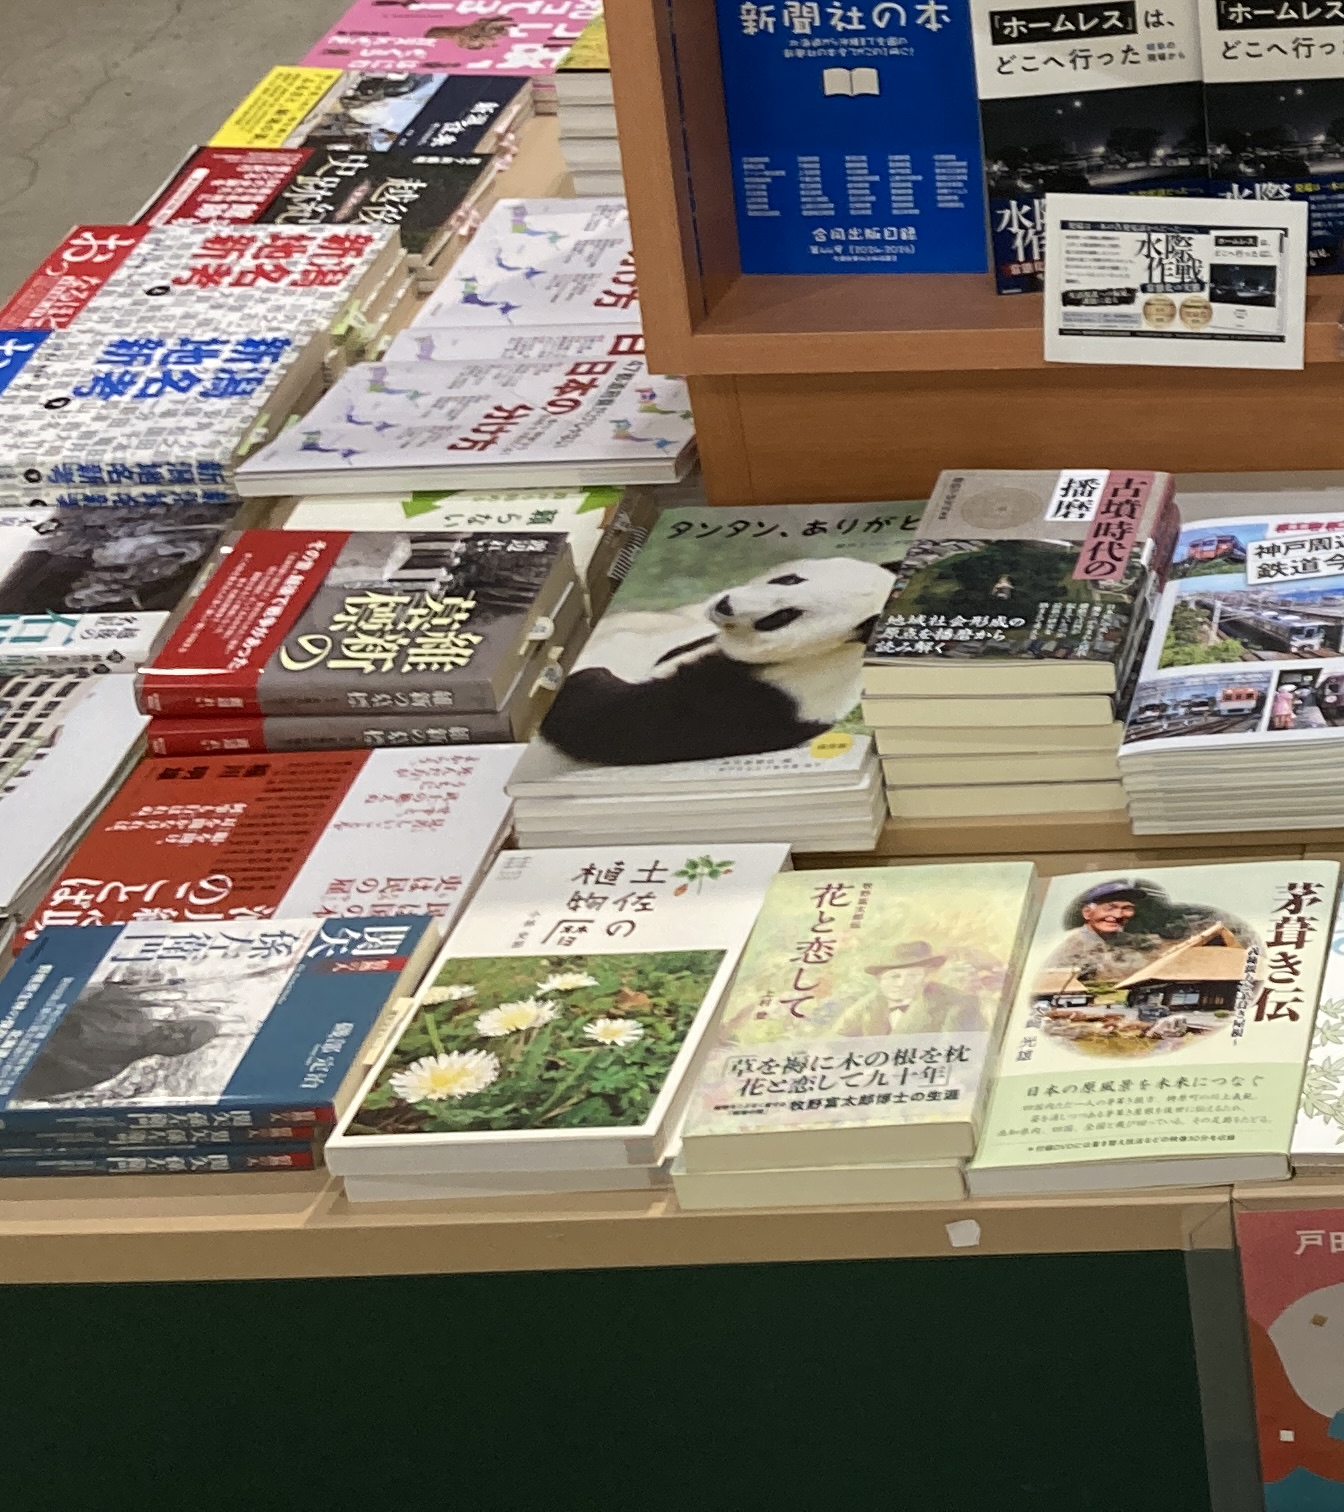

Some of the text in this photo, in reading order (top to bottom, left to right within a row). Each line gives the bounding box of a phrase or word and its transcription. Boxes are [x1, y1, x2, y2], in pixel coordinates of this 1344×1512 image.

[739, 1, 951, 36] 新聞社の本
[996, 44, 1141, 76] どこへ行った
[538, 361, 615, 415] 日本の
[448, 403, 534, 453] 分け方
[1056, 477, 1100, 520] 播磨
[1083, 476, 1140, 577] 古墳時代の
[328, 589, 479, 634] 墓標
[280, 633, 486, 676] 維新の
[606, 861, 669, 939] 土佐の
[111, 925, 413, 964] 関矢孫左衛門
[779, 883, 850, 1020] 花と恋して
[1253, 881, 1325, 1024] 茅葺き伝
